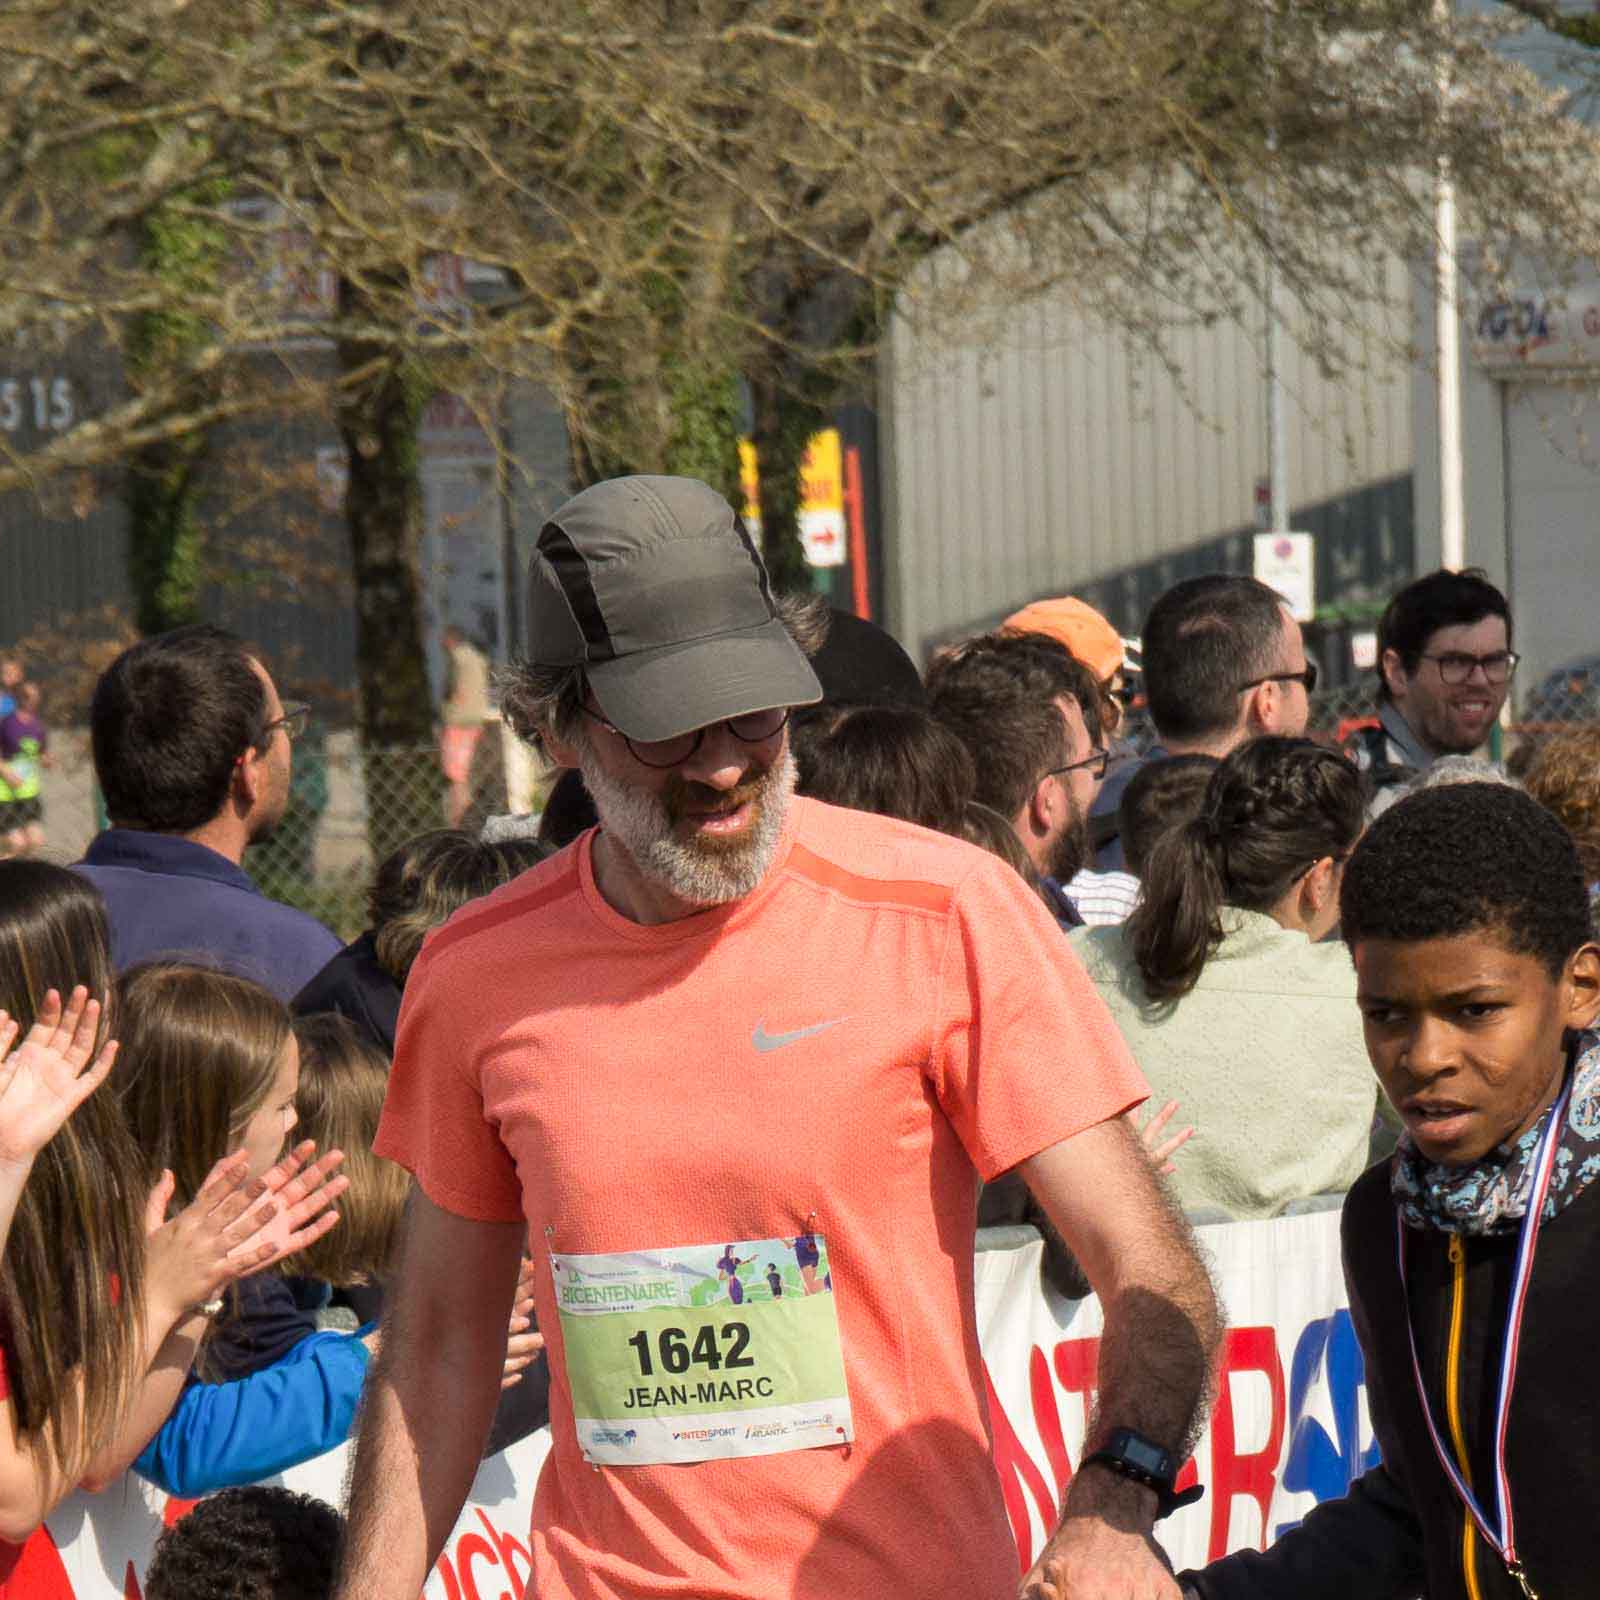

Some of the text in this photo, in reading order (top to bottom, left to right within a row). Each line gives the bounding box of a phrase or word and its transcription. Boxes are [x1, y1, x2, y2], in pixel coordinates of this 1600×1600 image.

[562, 1282, 676, 1304] BICENTENAIRE
[628, 1322, 755, 1376] 1642
[623, 1376, 774, 1408] JEAN-MARC
[681, 1427, 737, 1441] INTERSPORT
